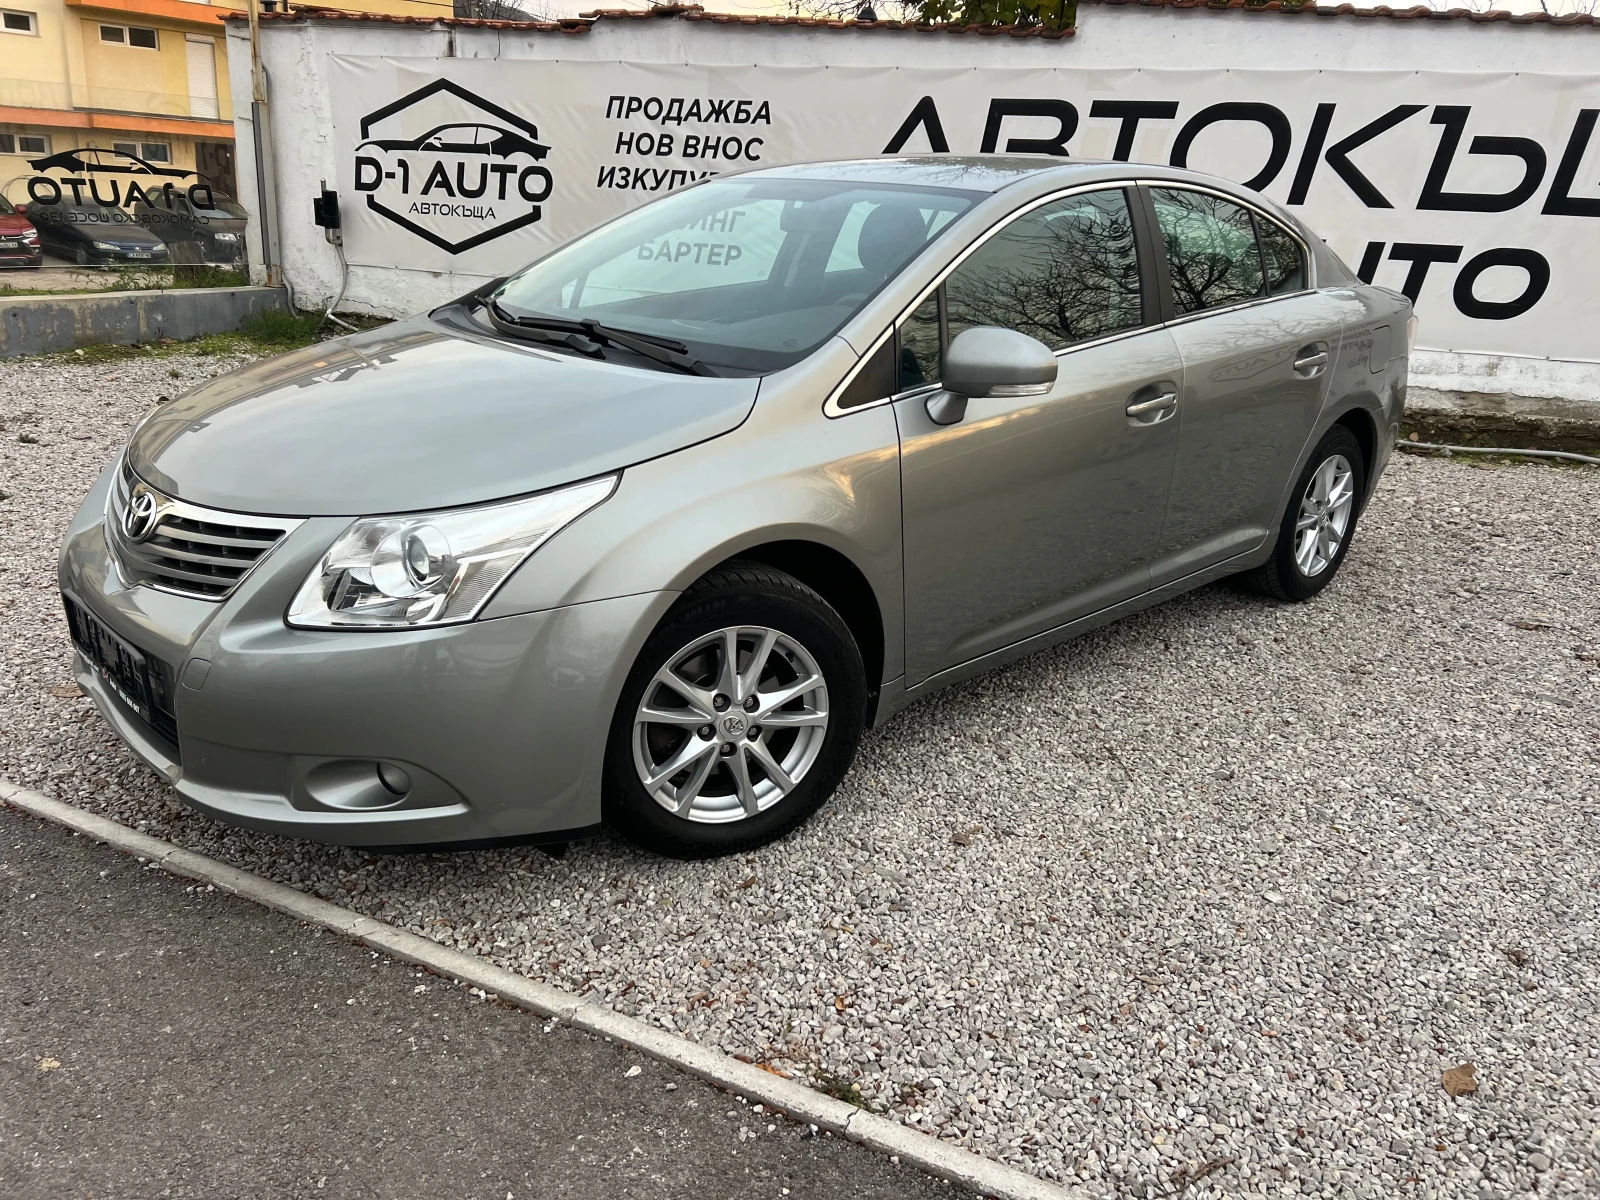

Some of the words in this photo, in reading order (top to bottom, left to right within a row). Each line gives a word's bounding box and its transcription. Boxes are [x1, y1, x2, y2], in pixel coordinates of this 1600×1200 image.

[605, 95, 772, 126] ПРОДАЖБА
[615, 131, 674, 156] НОВ
[682, 134, 765, 161] ВНОС
[354, 155, 410, 195] D-1
[420, 160, 554, 203] AUTO
[596, 165, 720, 191] ИЗКУП
[408, 201, 497, 221] АВТОКЪЩА
[637, 239, 742, 267] БАРТЕР
